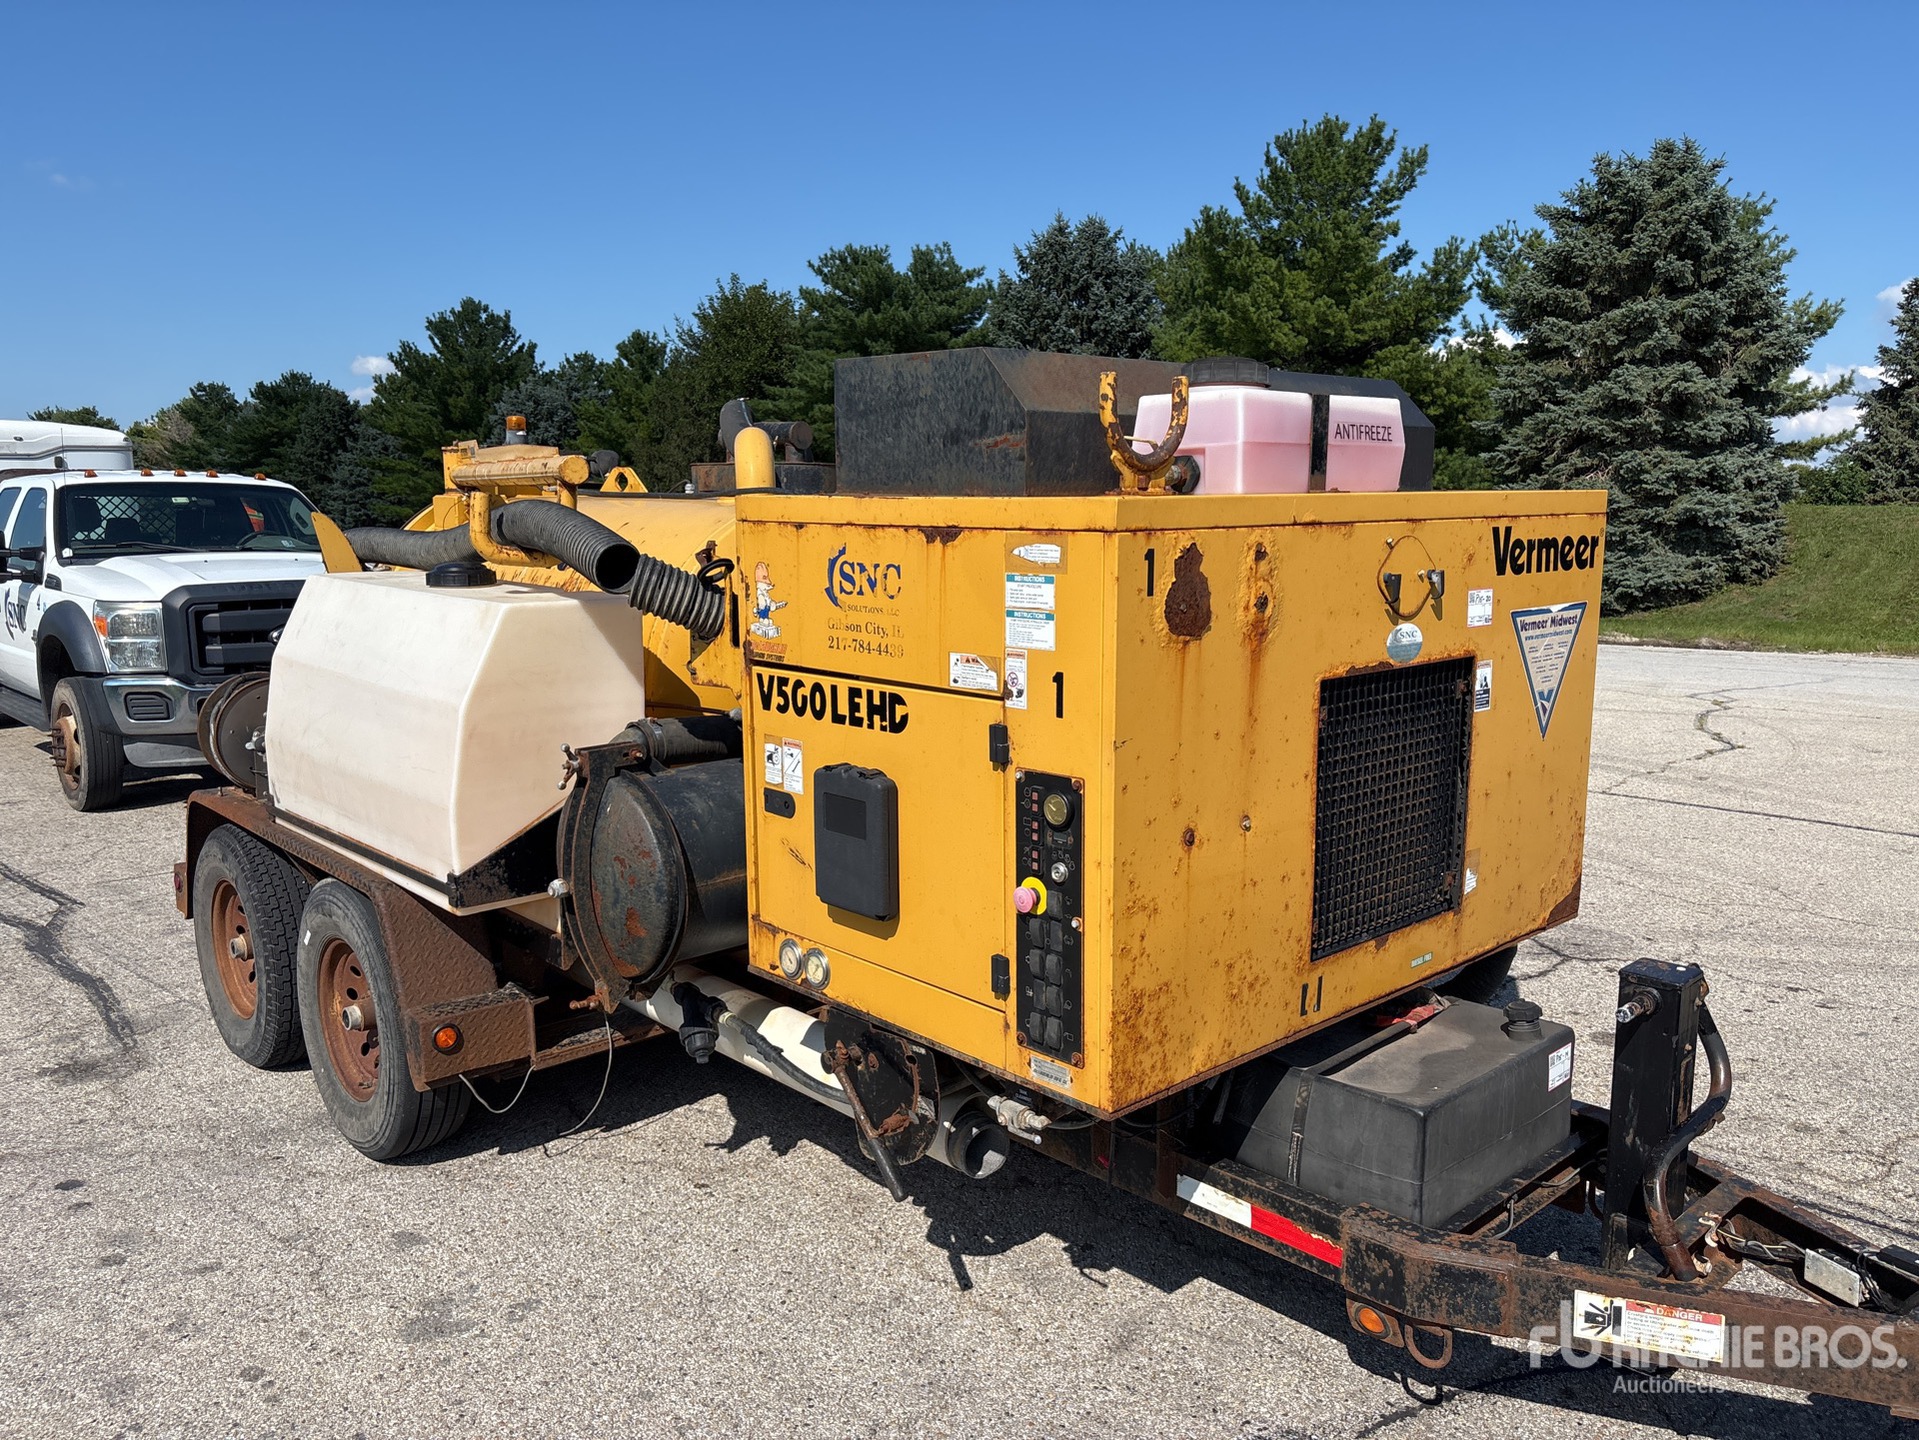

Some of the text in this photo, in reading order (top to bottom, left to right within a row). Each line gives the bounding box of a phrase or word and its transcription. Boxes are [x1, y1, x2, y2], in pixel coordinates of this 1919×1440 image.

[1334, 423, 1393, 442] ANTIFREEZE
[1491, 526, 1600, 576] Vermeer
[839, 560, 902, 600] SNC
[1143, 548, 1155, 597] 1
[847, 603, 884, 614] SOLUTIONS
[827, 617, 863, 633] Gibson
[865, 621, 889, 639] City,
[1519, 614, 1578, 632] Vermeer Midwest
[827, 635, 904, 659] 217-784-4439
[1051, 671, 1065, 719] 1
[1656, 1307, 1704, 1322] DANGER
